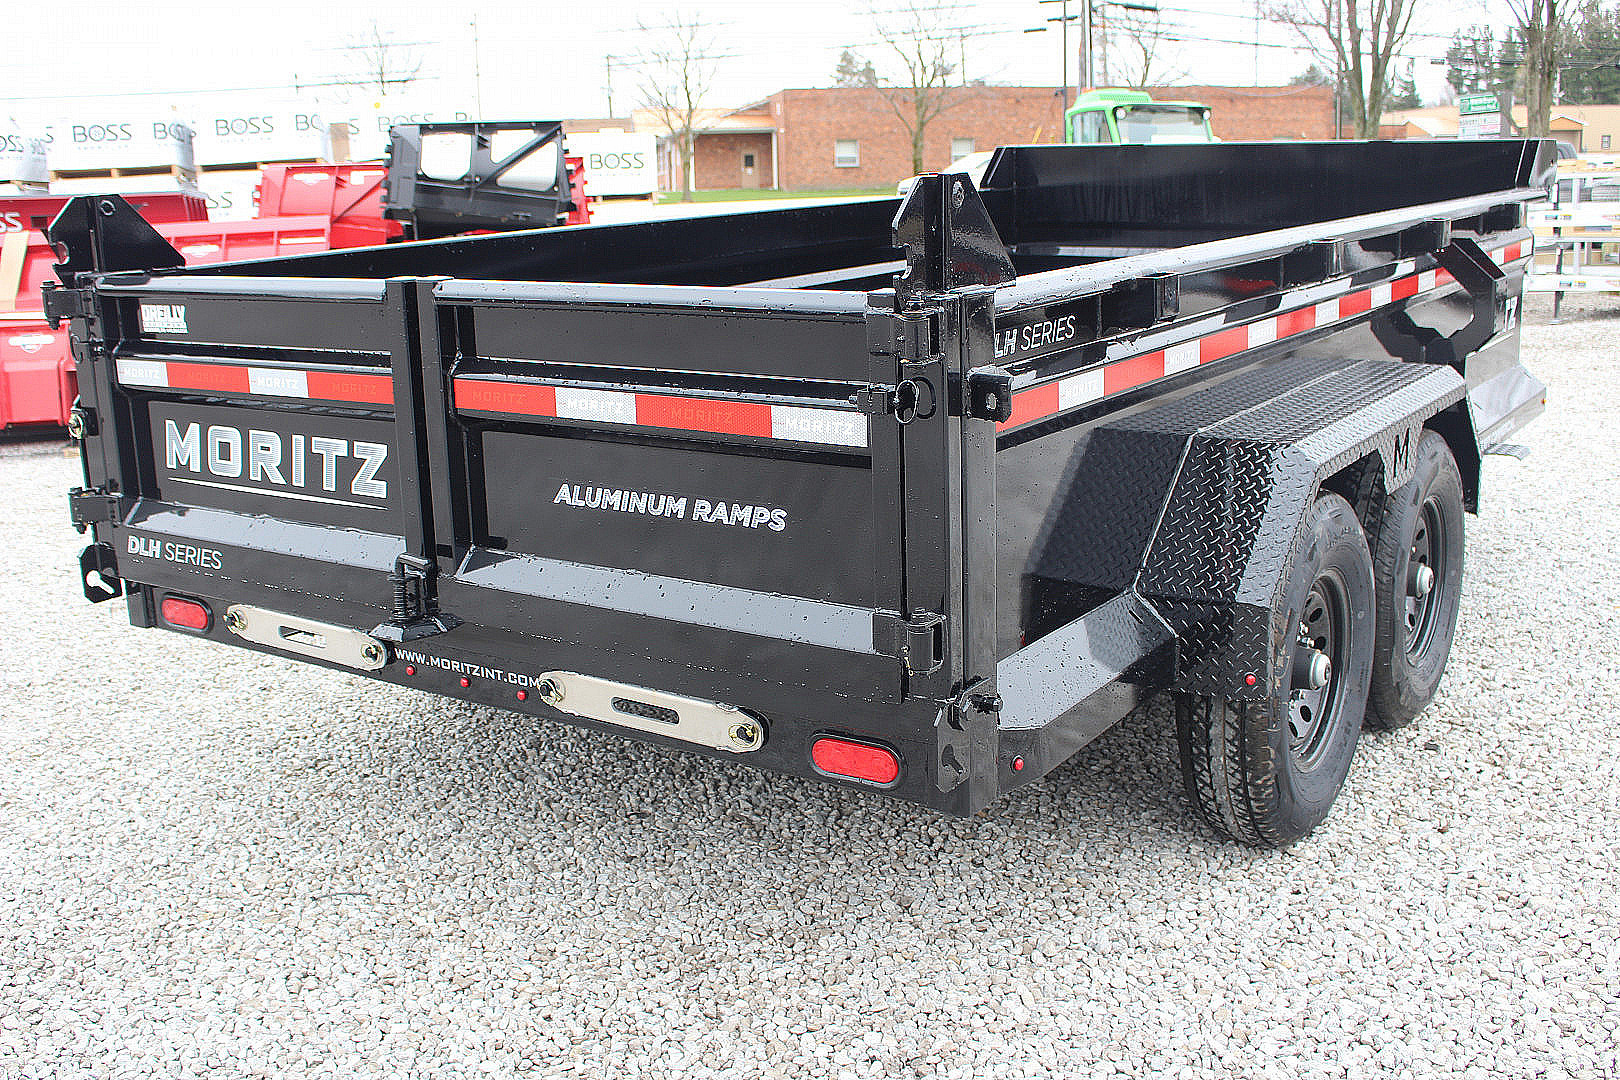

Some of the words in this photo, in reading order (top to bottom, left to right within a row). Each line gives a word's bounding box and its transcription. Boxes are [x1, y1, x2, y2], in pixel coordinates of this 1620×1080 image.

[72, 123, 133, 143] BOSS
[215, 116, 274, 136] BOSS
[590, 152, 645, 170] BOSS
[994, 328, 1018, 358] LH
[1020, 314, 1076, 350] SERIES
[256, 375, 299, 390] MORITZ
[471, 390, 528, 405] MORITZ
[568, 398, 624, 416] MORITZ
[669, 407, 734, 425] MORITZ
[784, 417, 855, 436] MORITZ
[165, 420, 389, 499] MORITZ
[553, 483, 688, 519] ALUMINUM
[692, 499, 788, 532] RAMPS
[127, 535, 162, 560] DLH
[164, 542, 223, 570] SERIES
[394, 647, 540, 687] WWW.MORITZINT.COM
